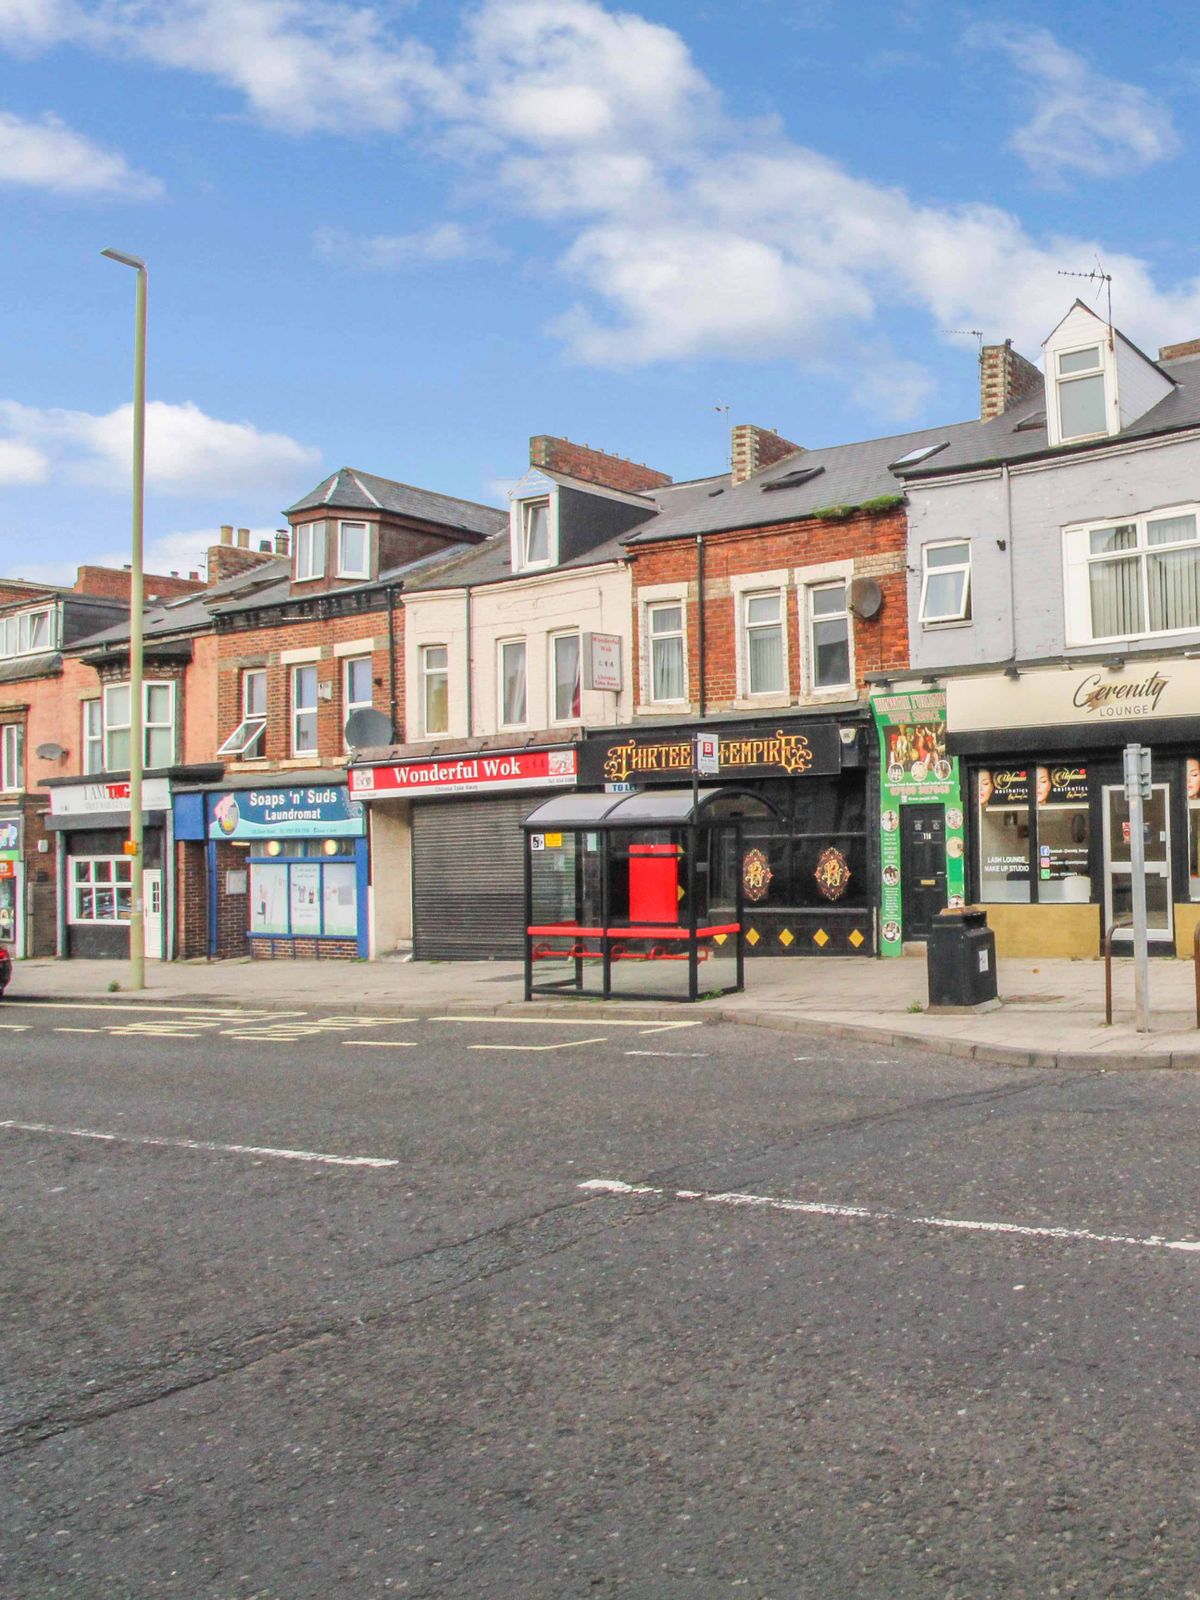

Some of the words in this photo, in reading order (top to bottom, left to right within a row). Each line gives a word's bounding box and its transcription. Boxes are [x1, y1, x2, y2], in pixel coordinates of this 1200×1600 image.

[1099, 705, 1149, 717] LOUNGE
[394, 760, 479, 784] Wonderful
[482, 757, 521, 776] Wok
[612, 783, 623, 792] TO
[250, 793, 286, 808] Soaps
[307, 789, 338, 803] Suds
[265, 807, 321, 821] Laundromat
[1002, 855, 1026, 863] LOUNGE
